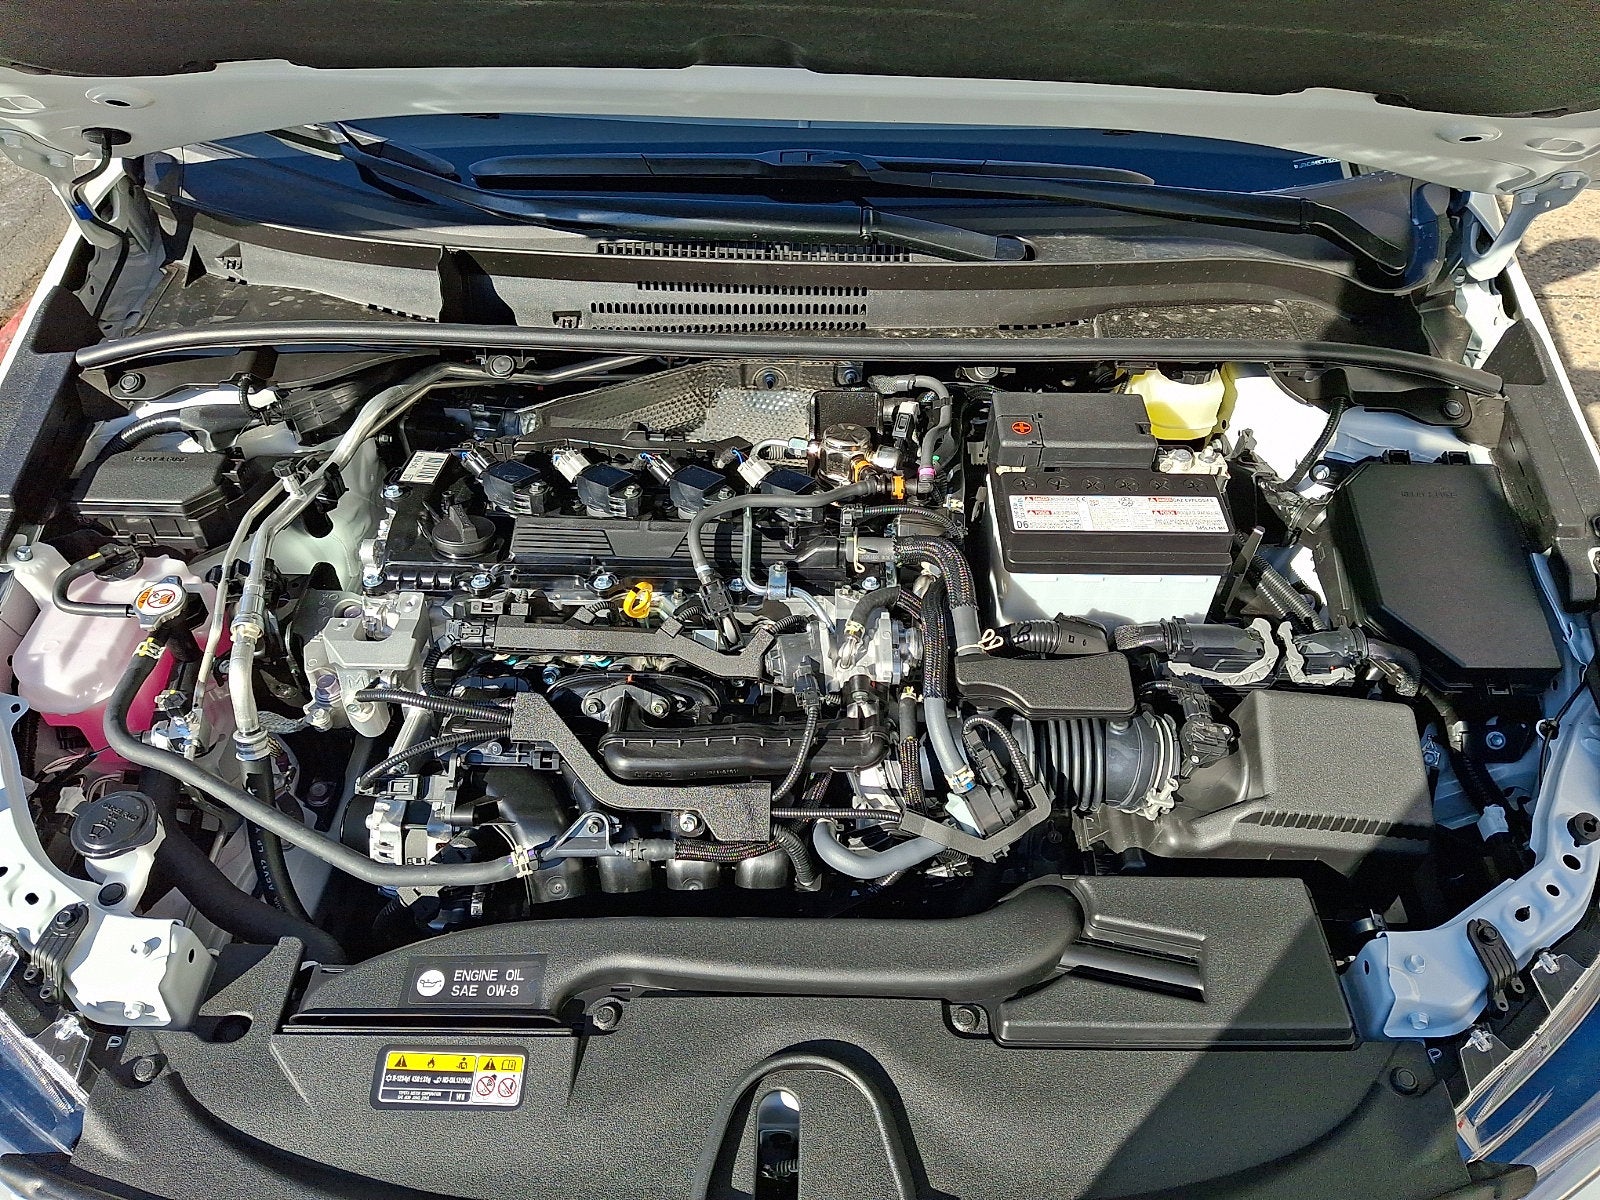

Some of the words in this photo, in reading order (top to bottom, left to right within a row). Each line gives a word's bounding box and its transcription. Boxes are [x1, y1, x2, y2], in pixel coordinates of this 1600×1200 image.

[1016, 520, 1029, 529] D6
[453, 969, 498, 981] ENGINE
[505, 969, 524, 981] OIL
[451, 985, 479, 997] SAE
[486, 984, 519, 997] 0W-8
